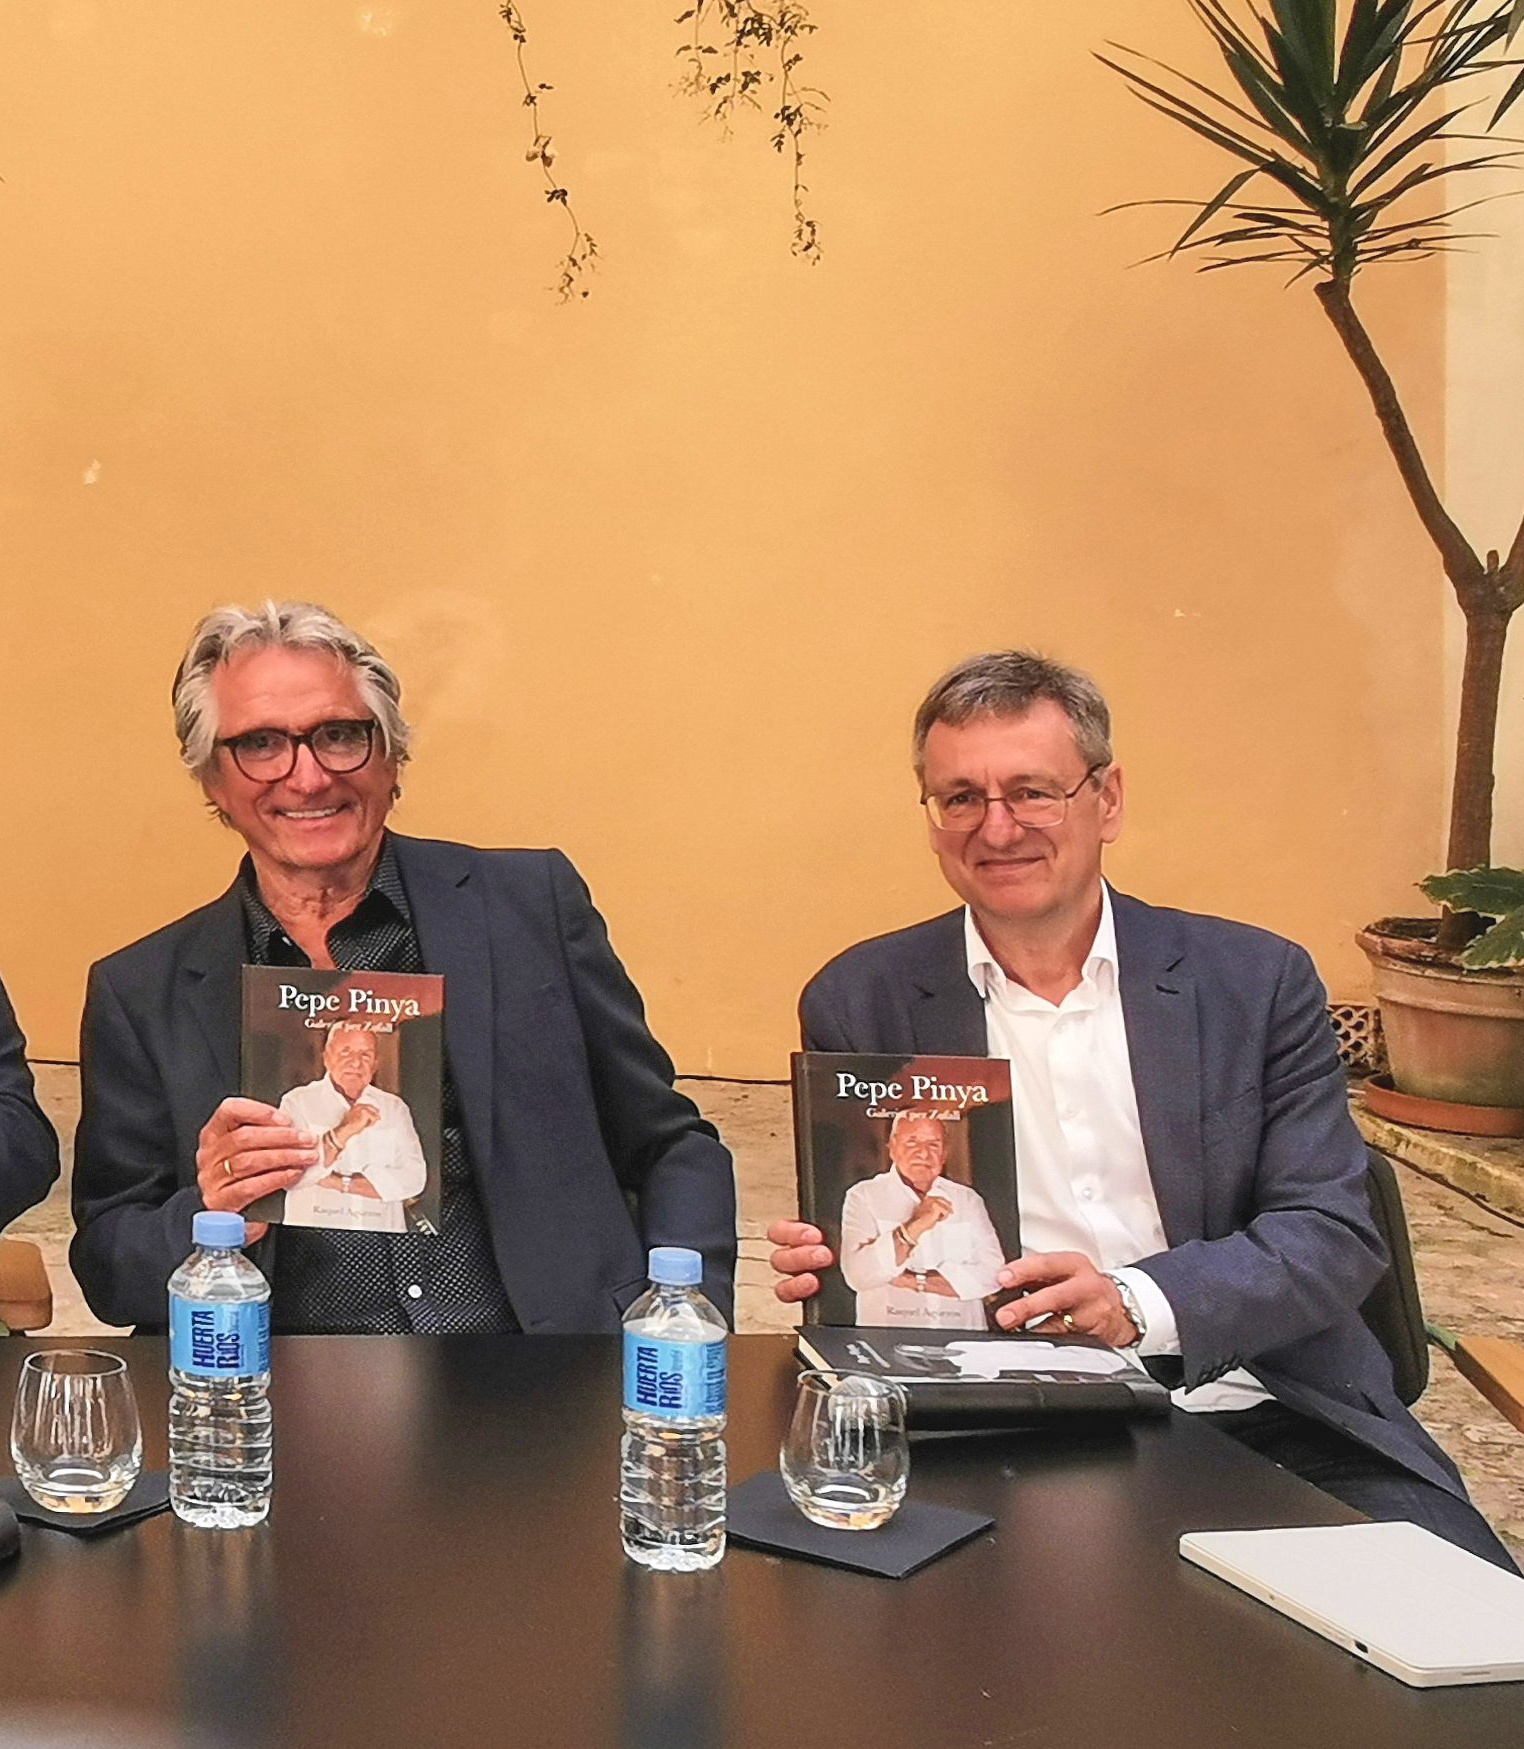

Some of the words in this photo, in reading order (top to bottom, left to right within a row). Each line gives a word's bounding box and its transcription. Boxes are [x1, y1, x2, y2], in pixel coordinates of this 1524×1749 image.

[278, 984, 340, 1017] Pepe
[348, 988, 421, 1022] Pinya
[835, 1072, 903, 1106] Pepe
[910, 1075, 989, 1108] Pinya
[191, 1311, 215, 1368] HUERTA
[636, 1346, 659, 1407] HUERTA
